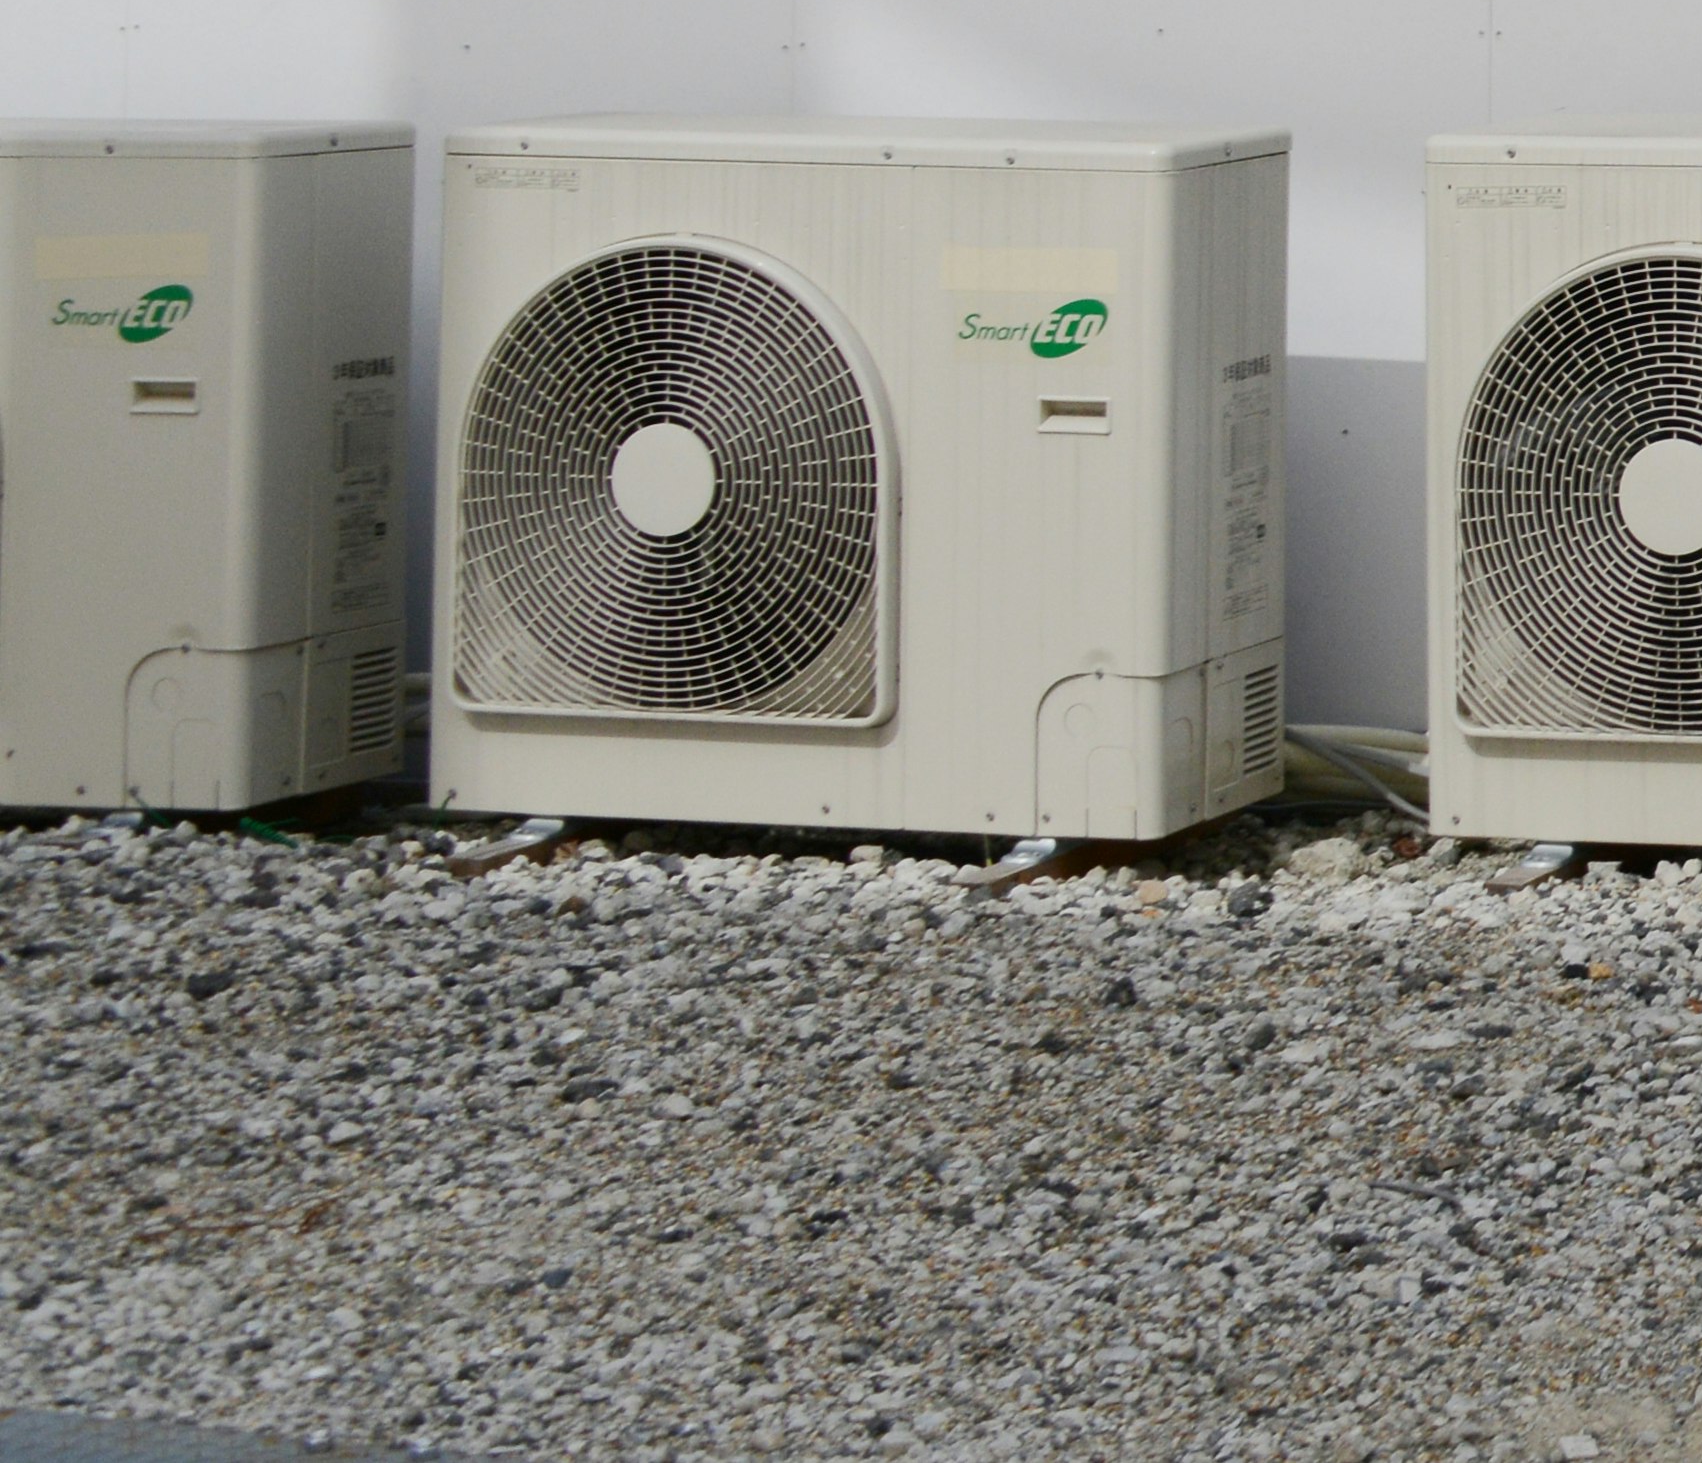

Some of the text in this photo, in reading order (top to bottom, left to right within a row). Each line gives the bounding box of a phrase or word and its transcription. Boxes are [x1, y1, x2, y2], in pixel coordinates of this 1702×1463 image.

[51, 298, 189, 328] Smart ECO
[957, 312, 1107, 344] Smart ECO
